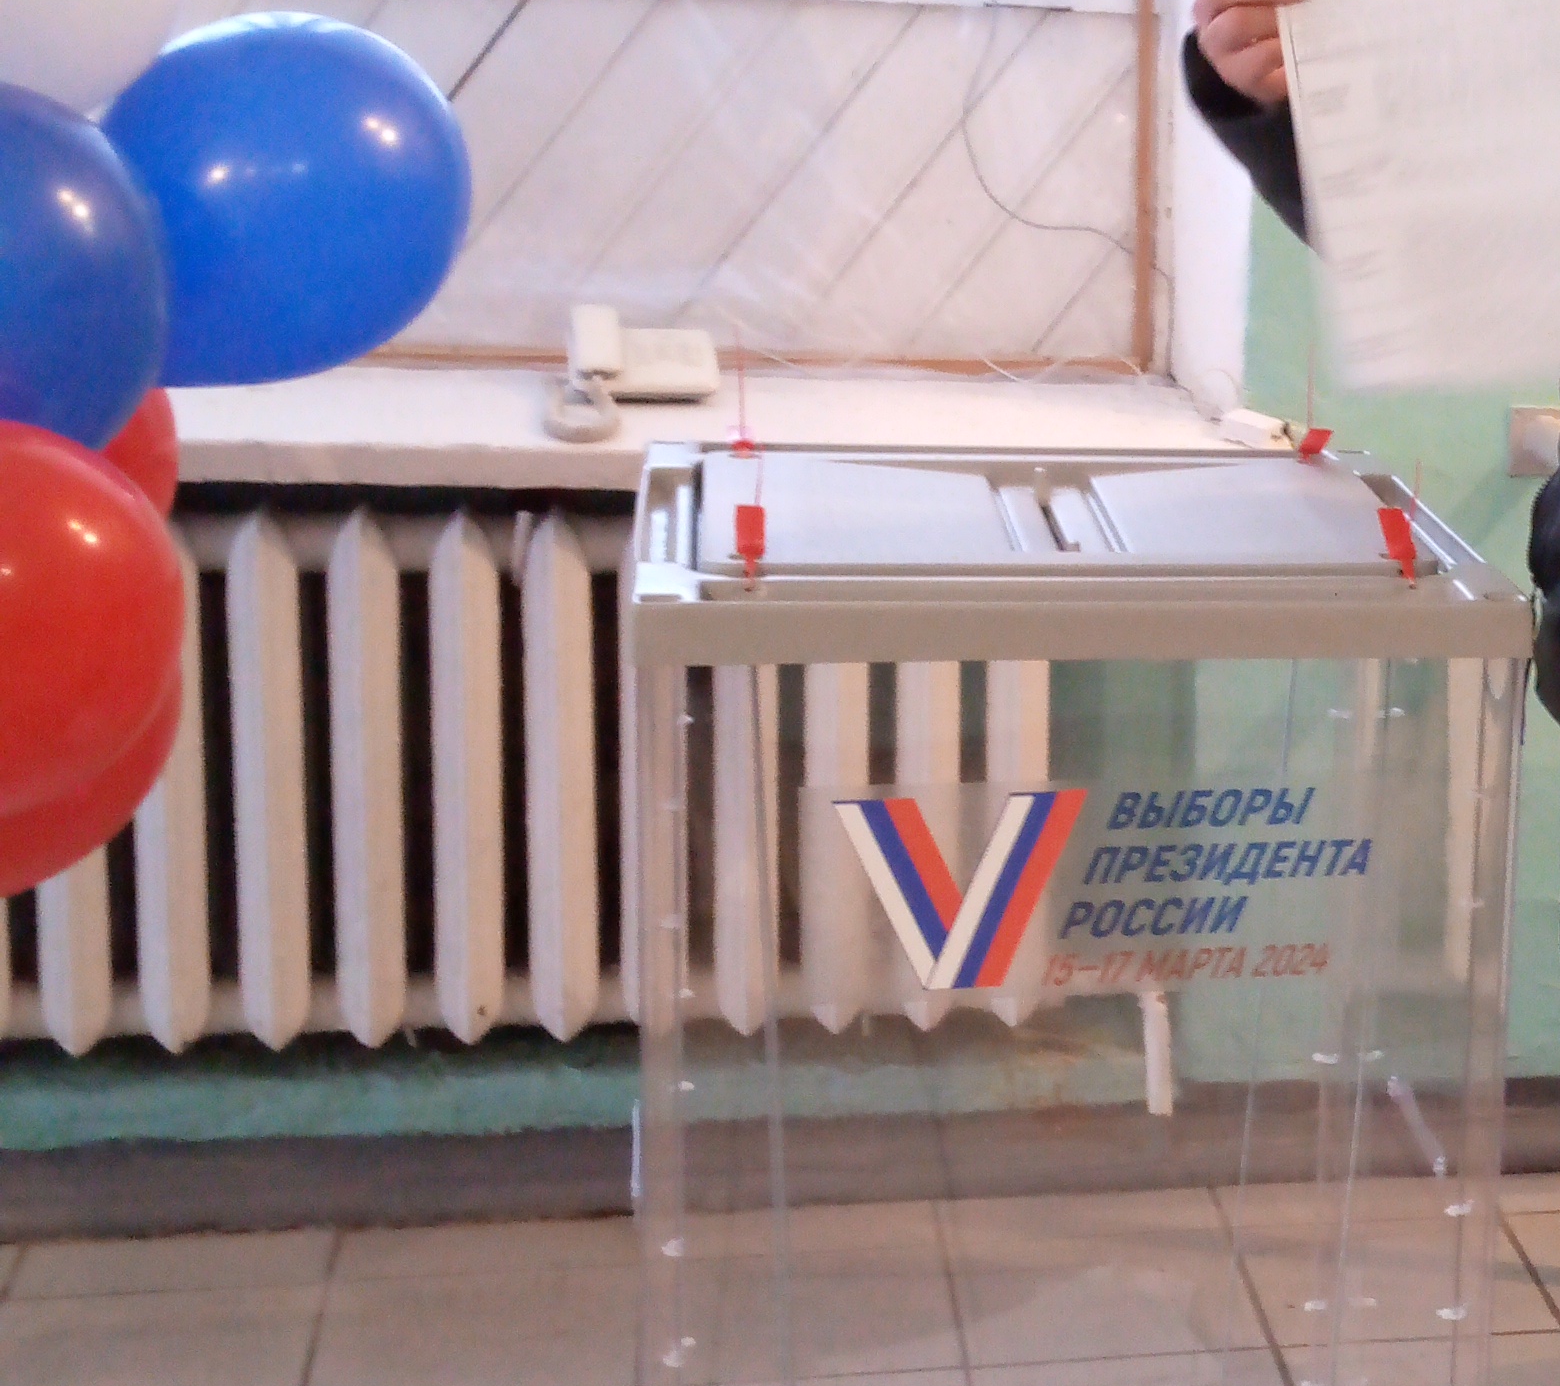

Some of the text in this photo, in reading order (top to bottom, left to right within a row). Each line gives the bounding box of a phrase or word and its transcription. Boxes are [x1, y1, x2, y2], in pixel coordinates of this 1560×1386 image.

[1106, 787, 1317, 830] ВЫБОРЫ
[1082, 838, 1374, 886] ПРЕЗИДЕНТА
[1057, 895, 1250, 940] РОССИИ
[1136, 947, 1248, 982] МАРТА
[1251, 941, 1331, 978] 2024
